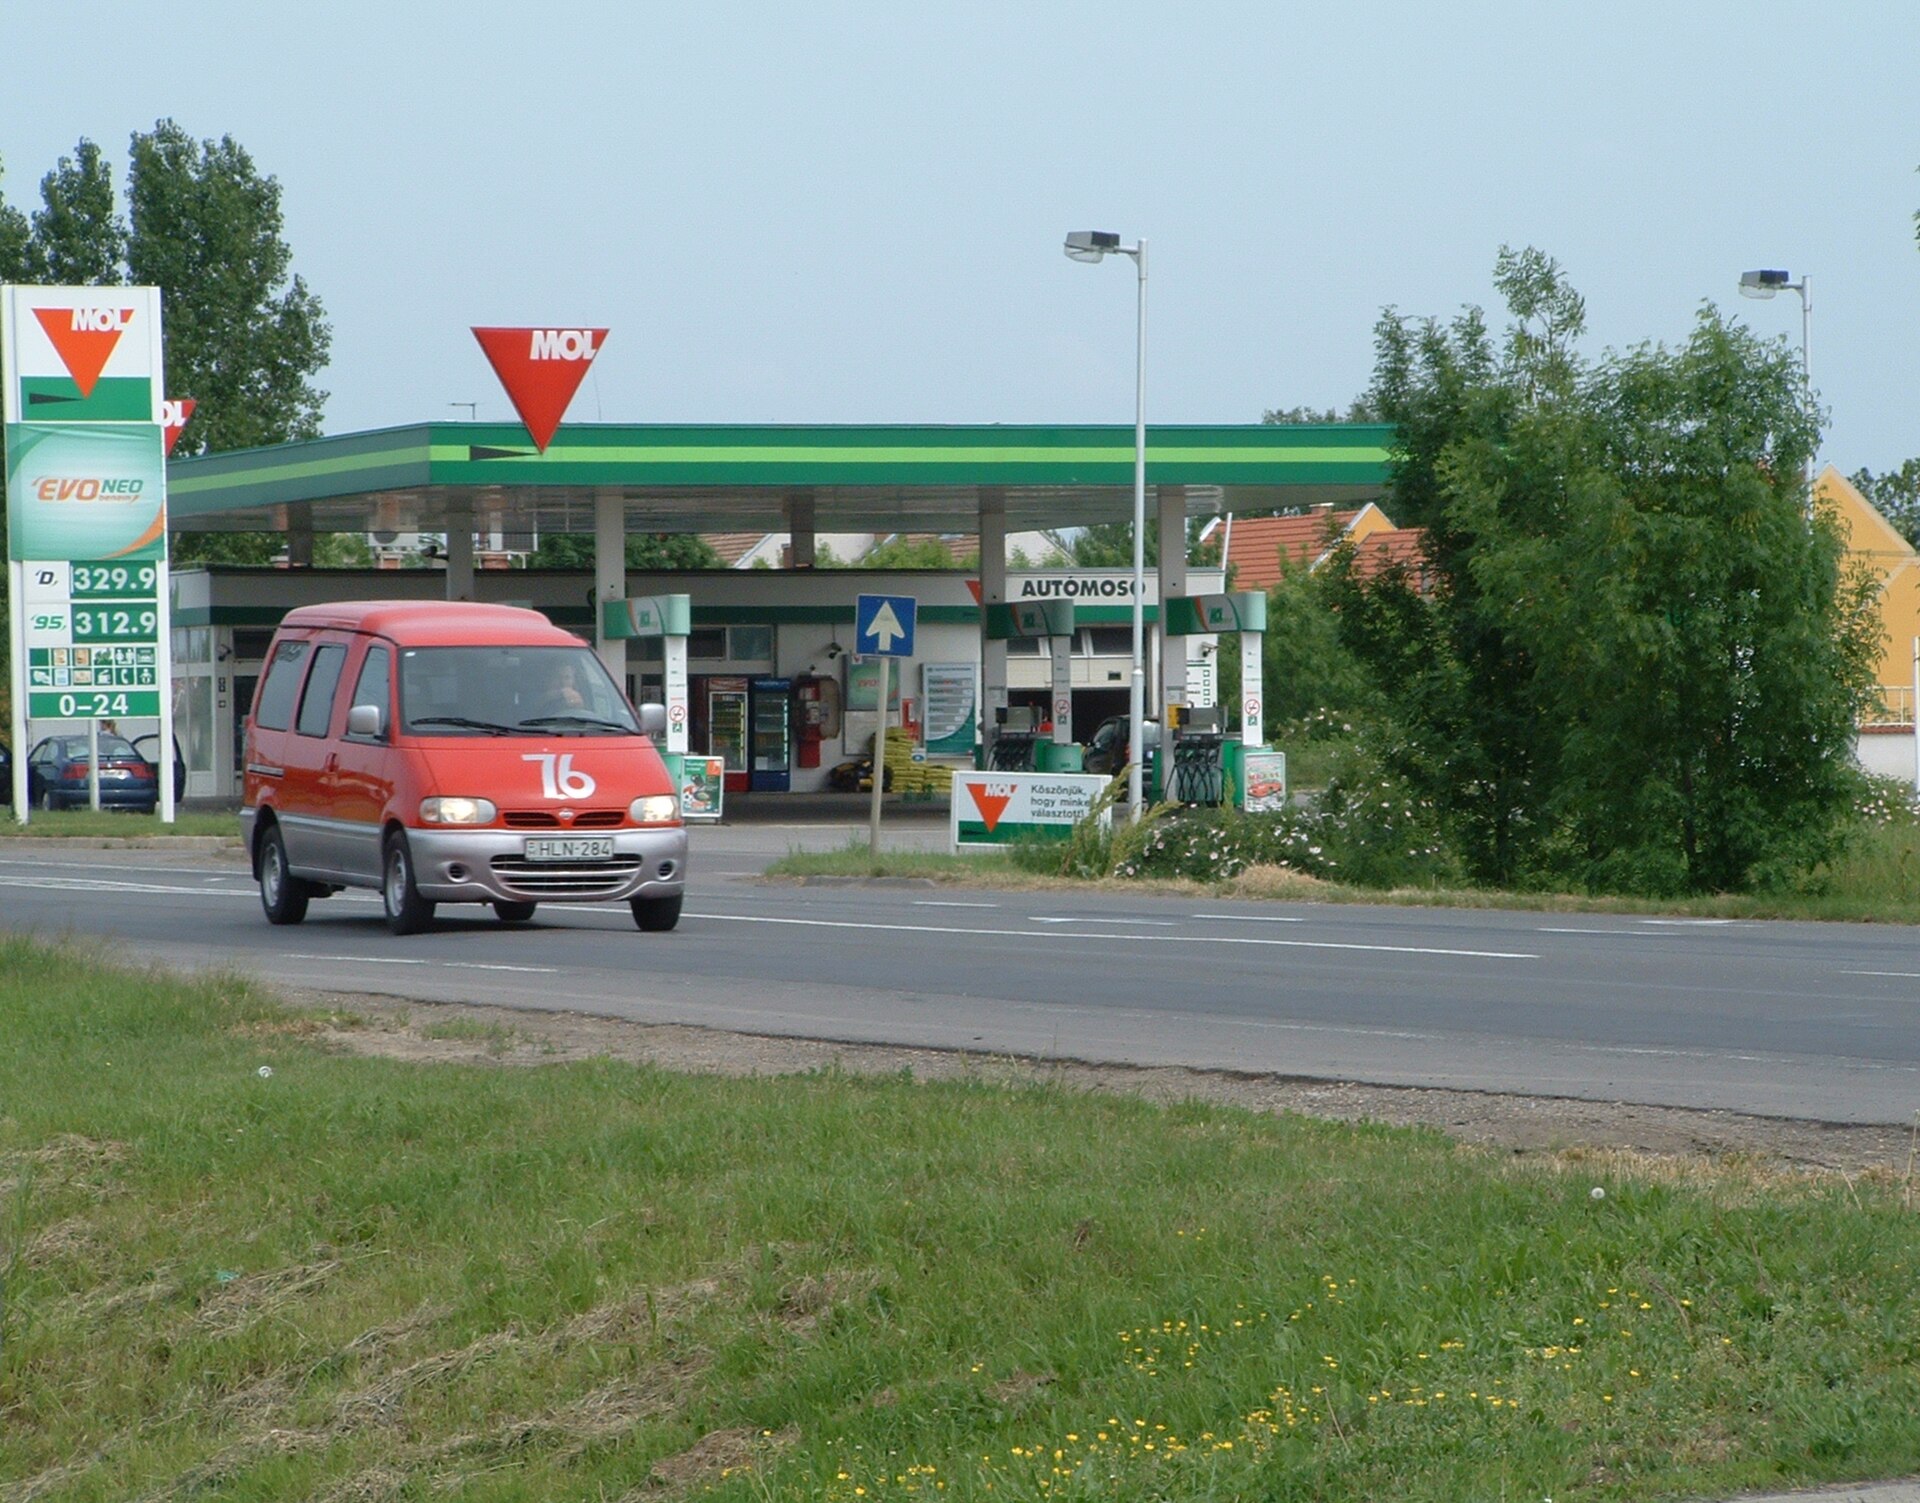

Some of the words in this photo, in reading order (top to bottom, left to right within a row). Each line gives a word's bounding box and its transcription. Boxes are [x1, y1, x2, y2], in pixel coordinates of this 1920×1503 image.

[71, 308, 126, 332] MOL
[529, 330, 598, 361] MOL
[161, 400, 187, 427] OL
[37, 478, 100, 501] EVO
[101, 479, 144, 494] NEO
[74, 567, 156, 590] 329.9
[75, 611, 156, 634] 312.9
[59, 693, 128, 716] 0-24
[984, 783, 1015, 797] MOL
[1030, 796, 1056, 808] hogy
[1060, 797, 1089, 807] minke
[540, 841, 610, 856] HLN-284
